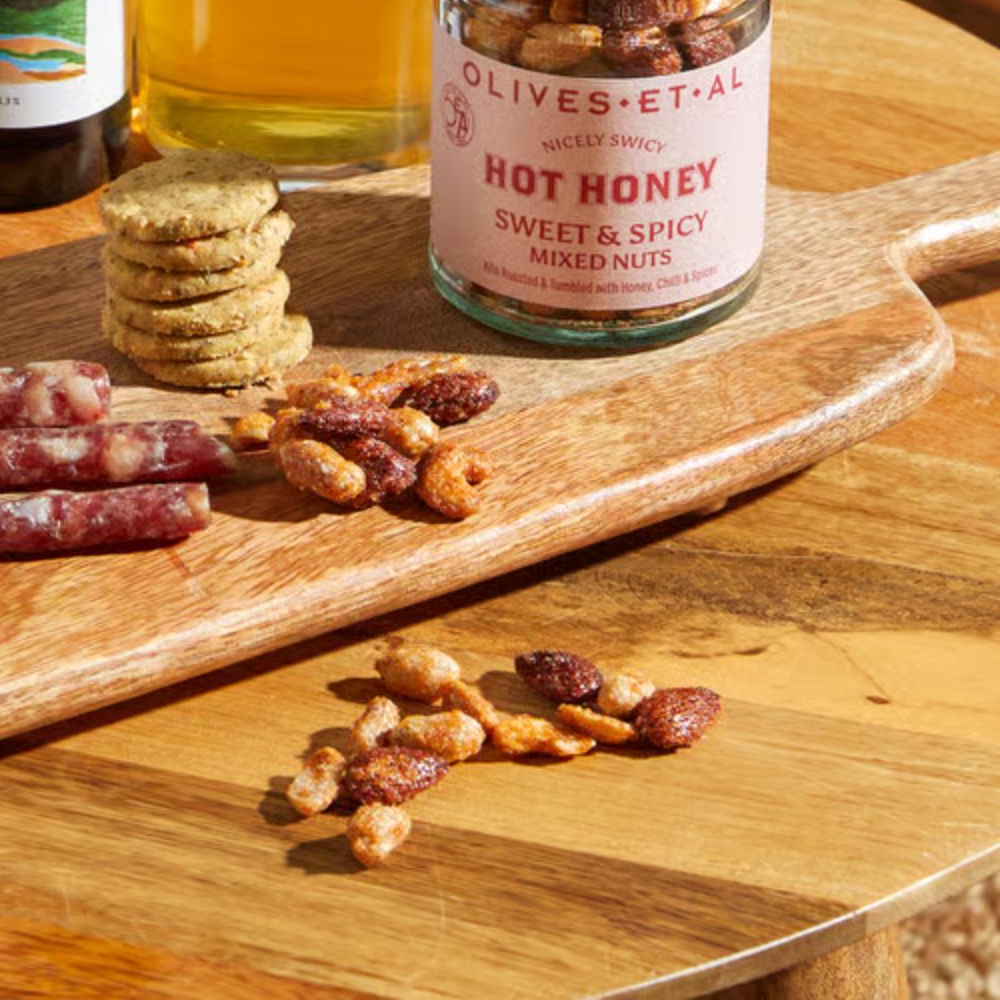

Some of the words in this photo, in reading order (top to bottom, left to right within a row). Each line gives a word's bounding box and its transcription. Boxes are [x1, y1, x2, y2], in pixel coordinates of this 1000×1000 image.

[541, 135, 605, 153] NICELY
[609, 134, 667, 153] SWICY
[484, 154, 564, 201] HOT
[580, 157, 718, 205] HONEY
[495, 208, 590, 245] SWEET
[597, 225, 621, 246] &
[629, 210, 709, 245] SPICY
[529, 246, 606, 271] MIXED
[613, 249, 671, 271] NUTS
[502, 266, 539, 288] Roasted
[540, 275, 547, 289] &
[595, 280, 619, 294] with
